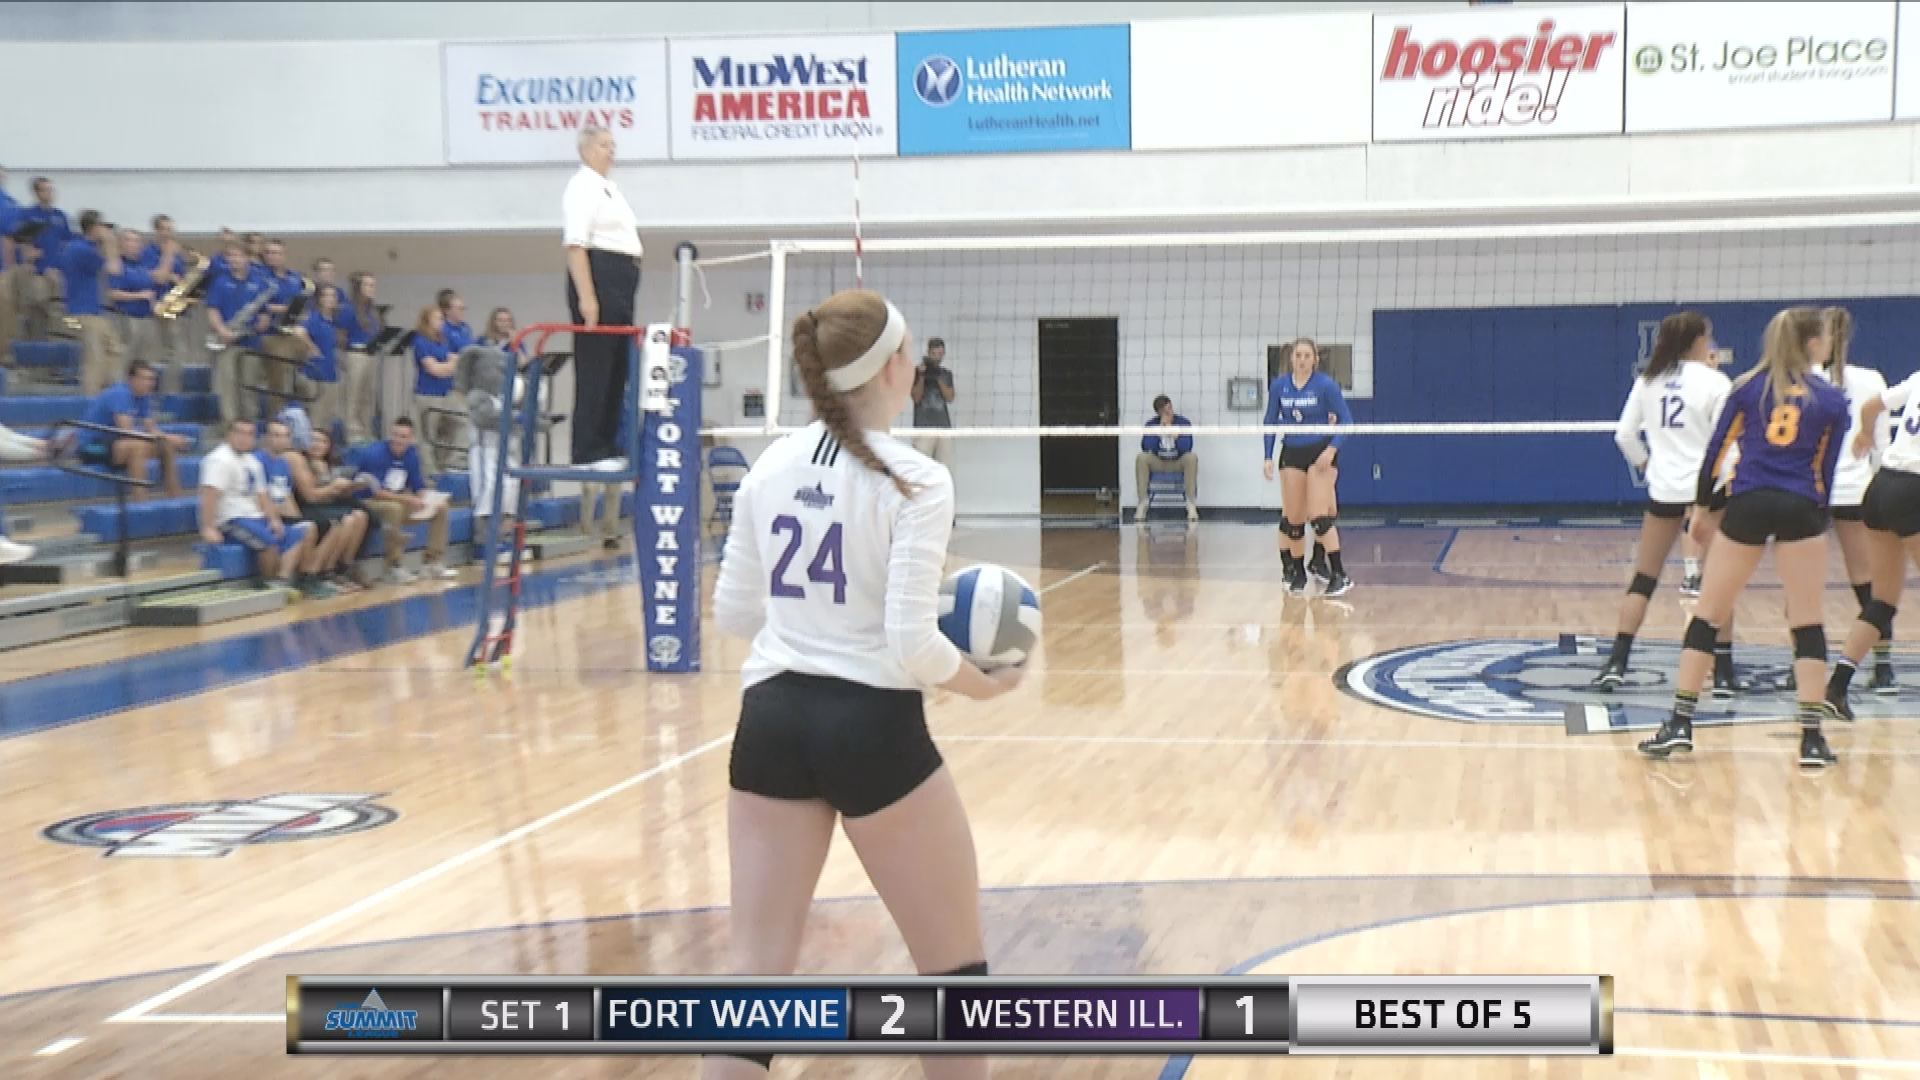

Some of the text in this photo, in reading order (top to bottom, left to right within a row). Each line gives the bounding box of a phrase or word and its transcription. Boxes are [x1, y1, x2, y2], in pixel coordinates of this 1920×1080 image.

[1380, 17, 1617, 82] hoosier
[1671, 35, 1889, 73] St. Joe Place
[966, 53, 1066, 79] Lutheran
[476, 73, 637, 105] EXCURSIONS
[694, 89, 871, 121] AMERICA
[967, 79, 1112, 103] Health Network
[1421, 62, 1571, 129] ride!
[479, 108, 635, 131] TRAILWAYS
[691, 120, 873, 140] FEDERAL CREDIT UNION
[968, 113, 1100, 131] LutheranHealth.net
[1661, 396, 1685, 428] 12
[1764, 405, 1801, 447] 8
[650, 504, 684, 625] WAYNE
[770, 514, 847, 605] 24
